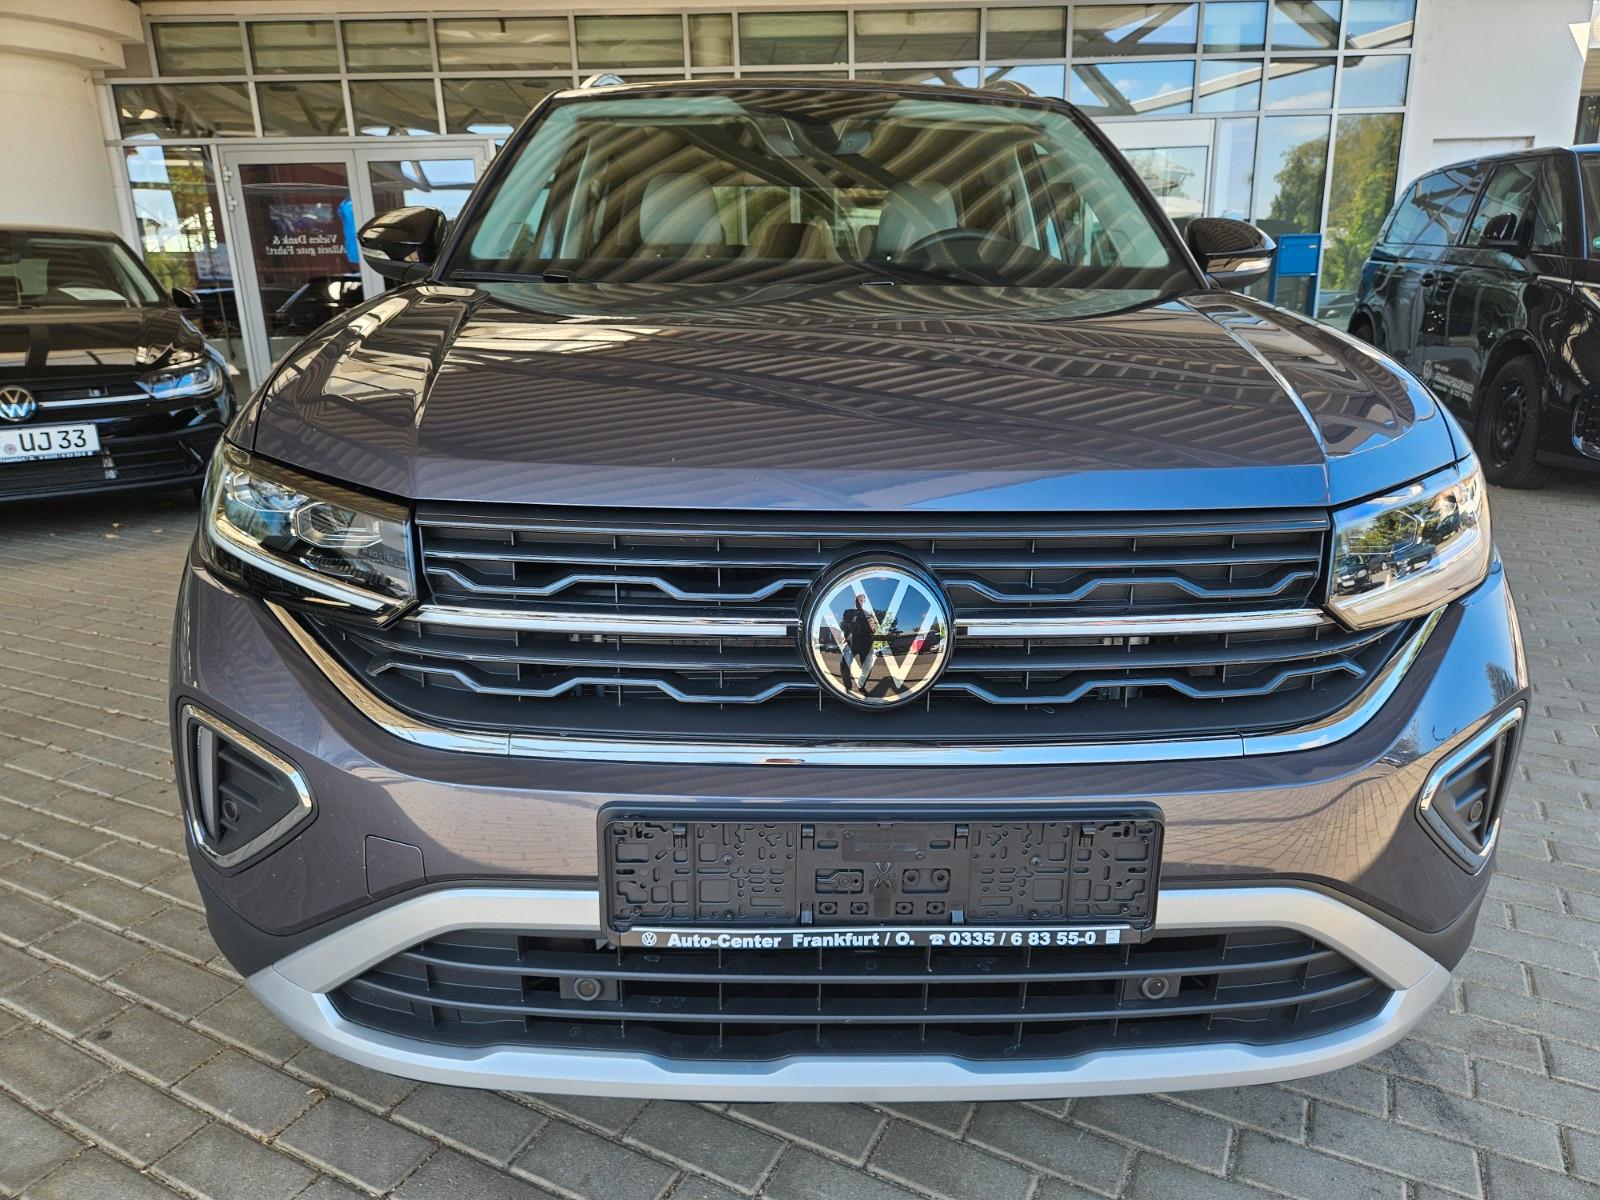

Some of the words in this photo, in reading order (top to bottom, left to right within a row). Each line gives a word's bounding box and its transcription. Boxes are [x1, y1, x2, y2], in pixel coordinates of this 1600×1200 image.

[19, 432, 52, 452] UJ
[57, 429, 87, 449] 33
[812, 571, 946, 700] VW
[667, 933, 782, 948] Auto-Center
[792, 932, 880, 947] Frankfurt
[895, 932, 915, 946] O.
[949, 931, 995, 946] 0335
[1010, 931, 1023, 946] 6
[1028, 931, 1050, 946] 83
[1056, 931, 1097, 945] 55-0
